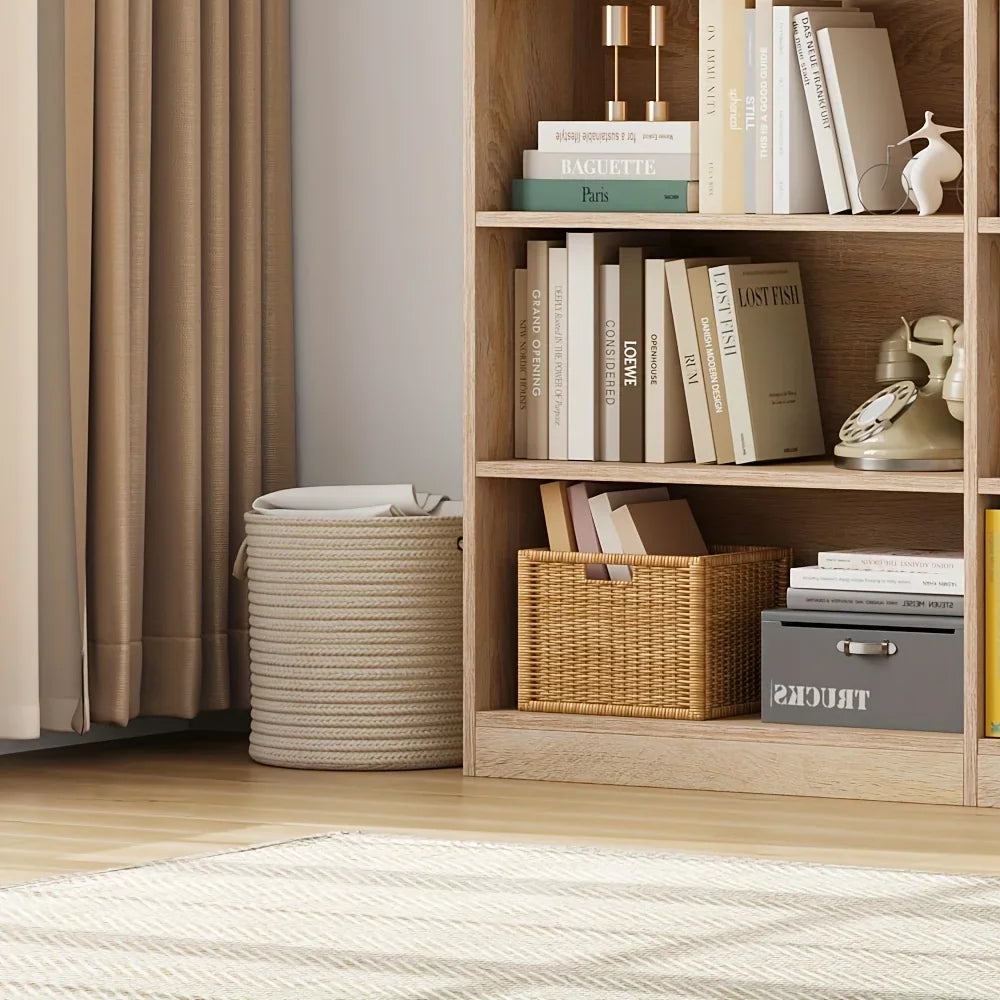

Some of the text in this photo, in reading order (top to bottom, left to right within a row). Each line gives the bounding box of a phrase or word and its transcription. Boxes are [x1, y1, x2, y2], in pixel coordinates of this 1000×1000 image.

[706, 25, 715, 117] ON IMMUNITY
[795, 38, 811, 86] neue stadt
[802, 17, 831, 130] DAS NEUE FRANKFURT
[745, 96, 755, 131] STILL
[759, 47, 768, 158] THIS IS A GOOD GUIDE
[627, 132, 636, 143] for
[561, 159, 656, 175] BAGUETTE
[582, 186, 608, 202] Paris
[713, 273, 737, 357] LOST FISH
[738, 285, 800, 307] LOST FISH
[532, 289, 541, 397] GRAND OPENING
[605, 320, 615, 405] CONSIDERED
[624, 340, 637, 386] LOEWE
[701, 317, 723, 413] DANISH MODERN DESIGN
[684, 354, 699, 386] RUM
